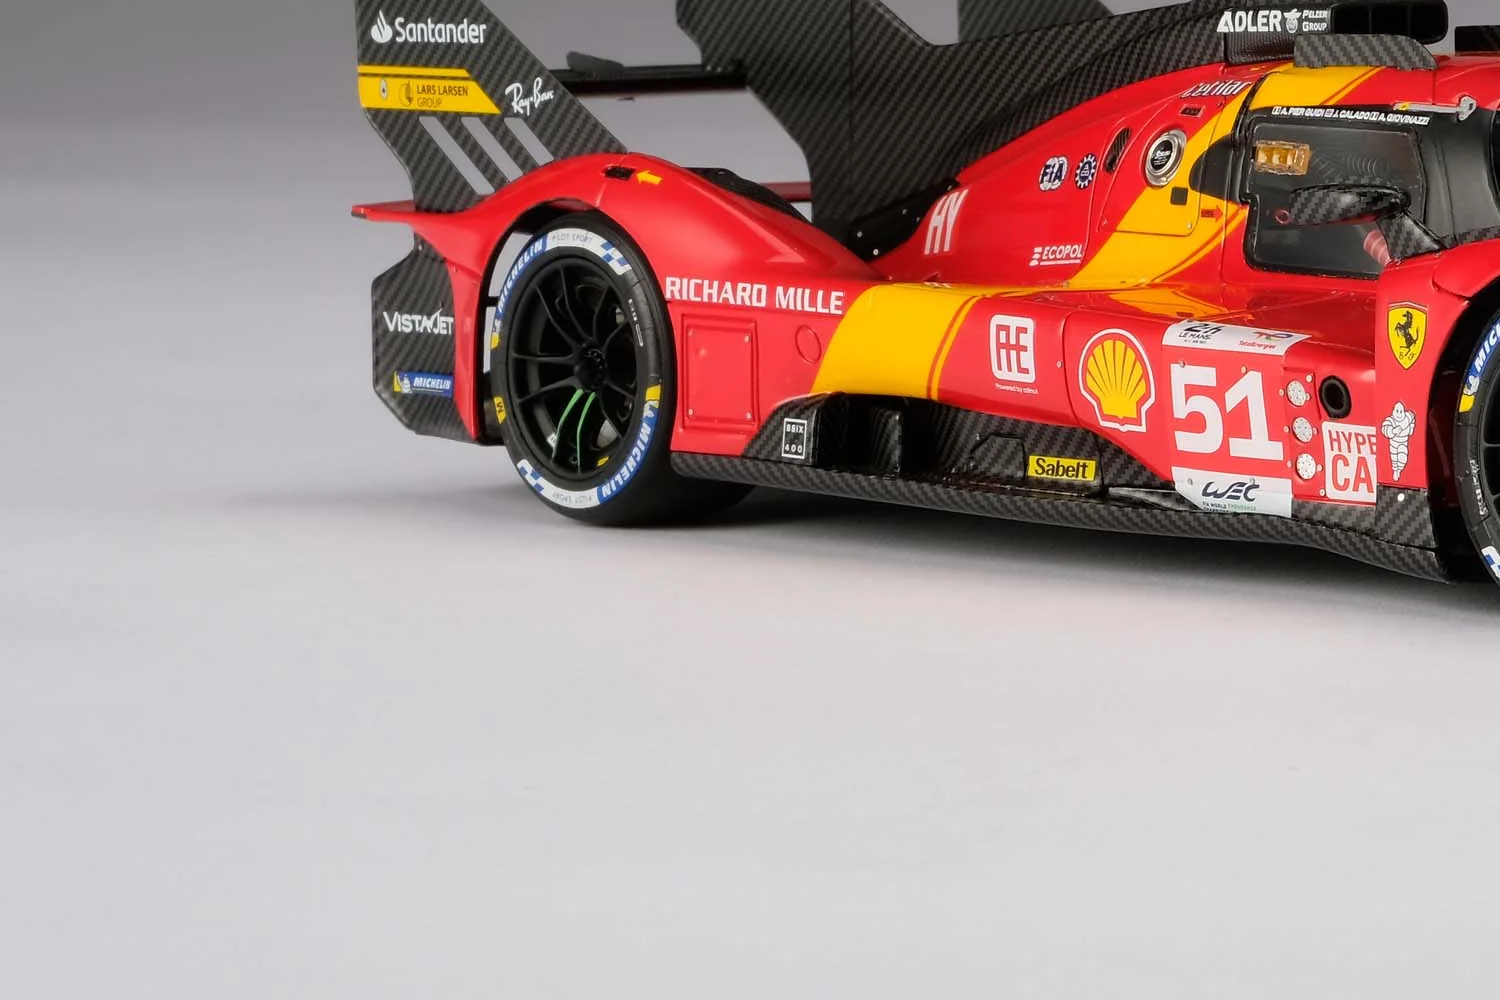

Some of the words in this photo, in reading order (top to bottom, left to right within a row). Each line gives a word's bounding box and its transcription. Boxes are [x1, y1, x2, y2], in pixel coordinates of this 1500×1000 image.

[396, 18, 486, 44] Santander
[1216, 8, 1282, 32] ADLER
[416, 84, 437, 95] LARS
[438, 85, 469, 96] LARSEN
[417, 98, 443, 107] GROUP
[1289, 107, 1305, 115] PIER
[1339, 110, 1371, 120] CALADO
[1040, 163, 1064, 184] FIA
[1042, 245, 1083, 260] ECOPOL
[497, 238, 544, 313] MICHELIN
[665, 276, 767, 307] RICHARD
[775, 286, 844, 315] MILLE
[413, 377, 451, 389] MICHELIN
[1170, 363, 1284, 461] 51
[602, 422, 652, 497] MICHELIN
[1034, 457, 1089, 479] Sabelt
[1332, 454, 1376, 494] CA
[1202, 481, 1260, 502] WEC
